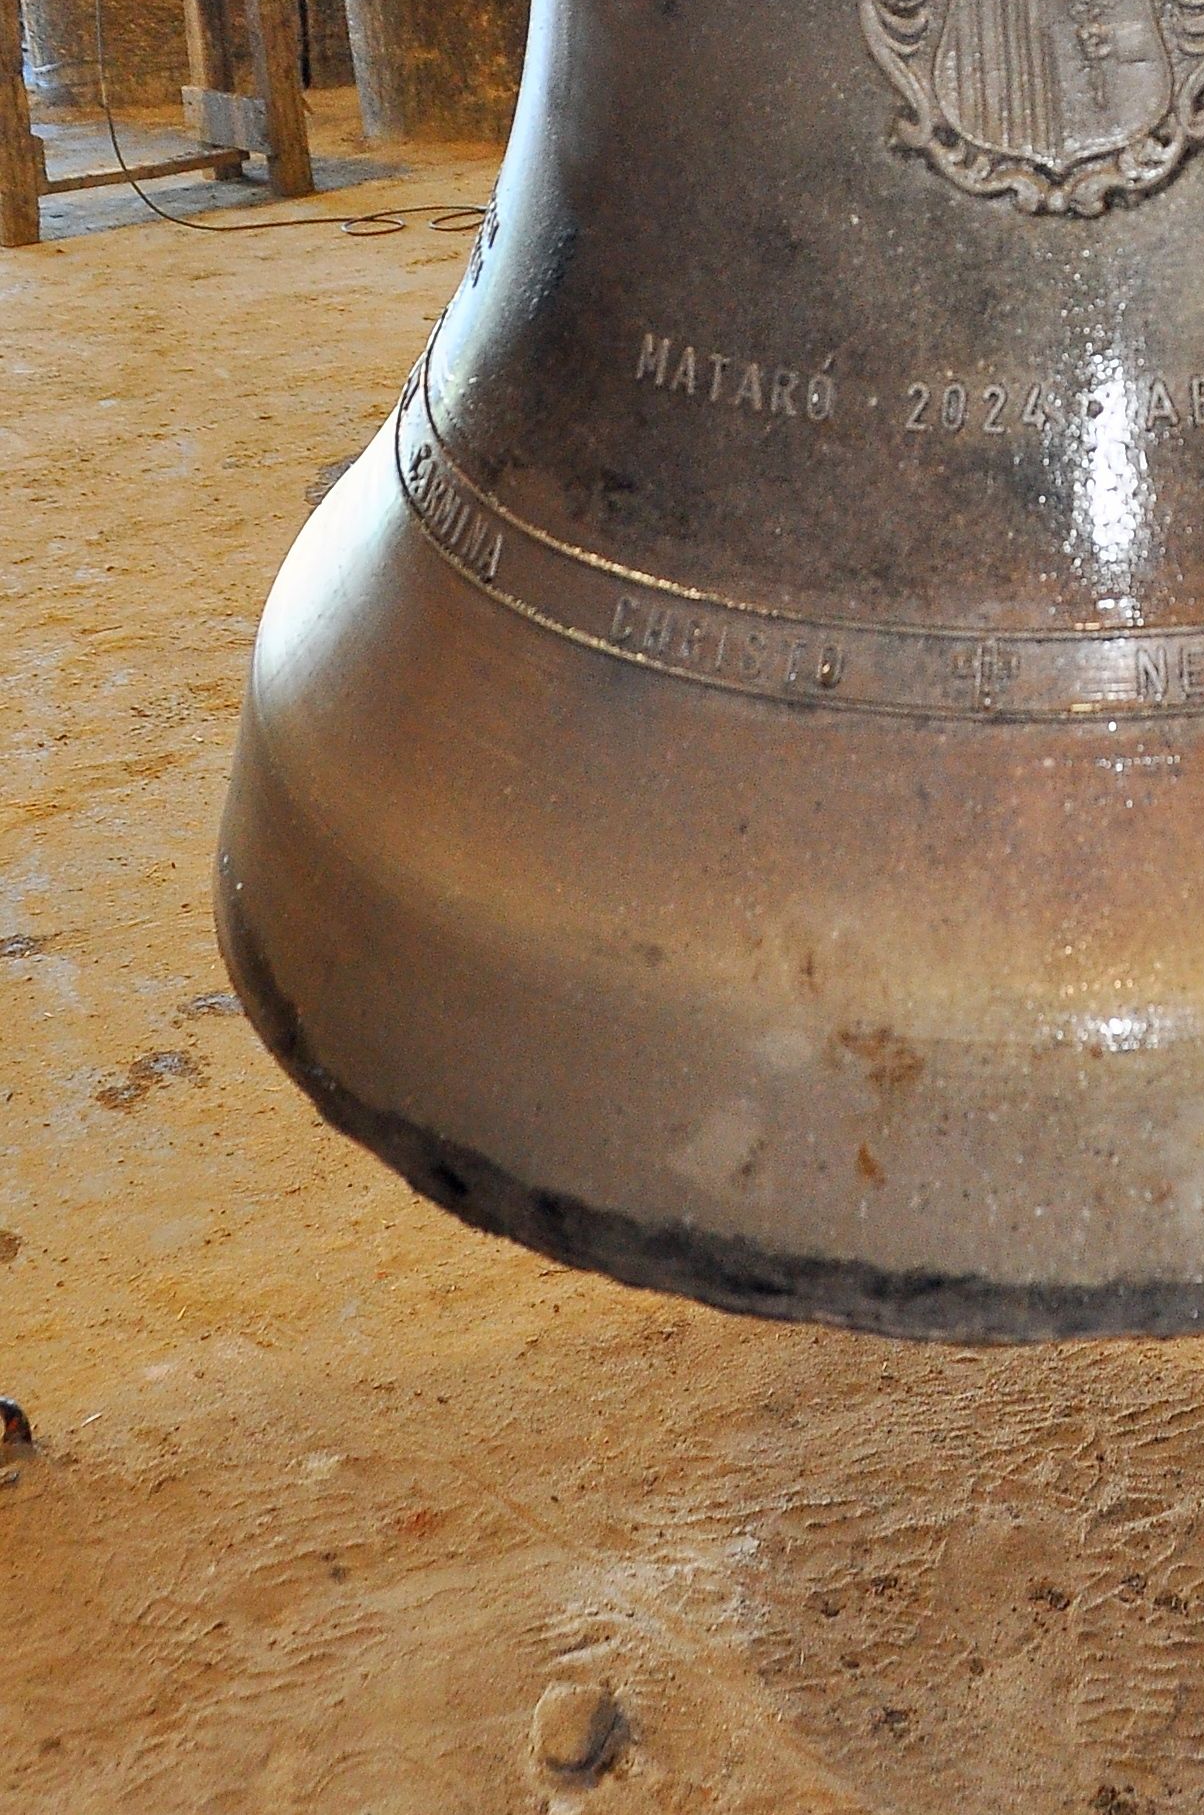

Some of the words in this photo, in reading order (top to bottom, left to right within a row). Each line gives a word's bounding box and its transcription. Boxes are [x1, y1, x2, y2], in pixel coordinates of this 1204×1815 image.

[635, 333, 836, 422] MATARÓ
[902, 381, 1049, 437] 2024
[608, 594, 845, 690] CHRISTO
